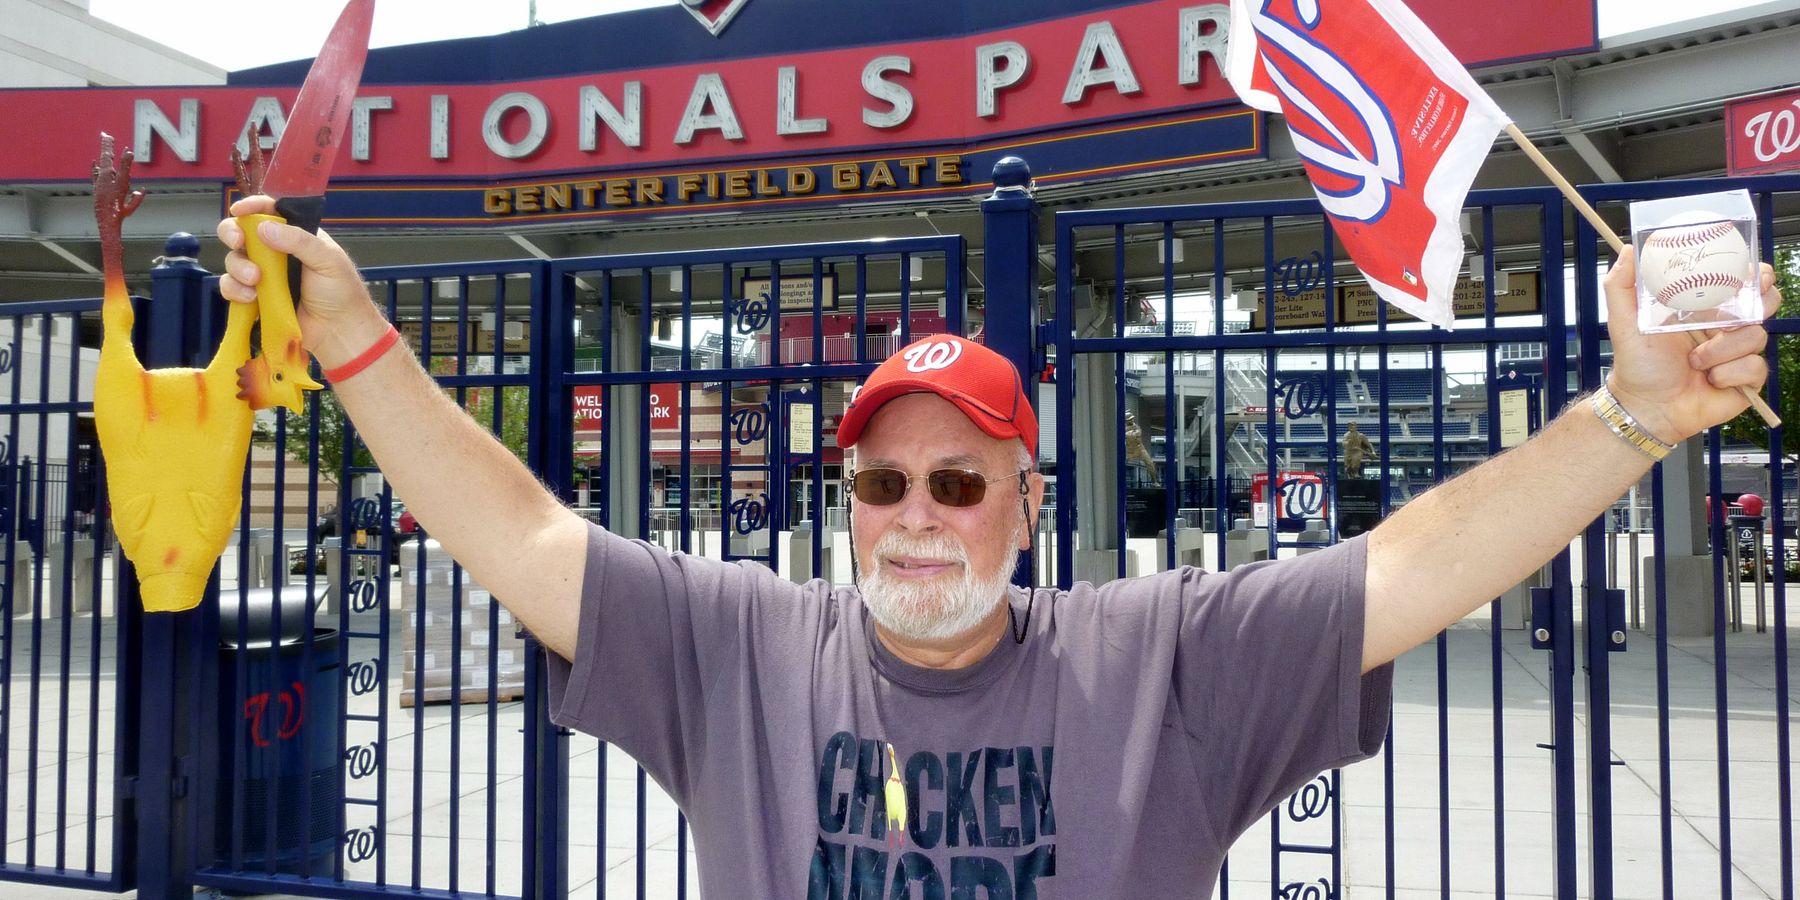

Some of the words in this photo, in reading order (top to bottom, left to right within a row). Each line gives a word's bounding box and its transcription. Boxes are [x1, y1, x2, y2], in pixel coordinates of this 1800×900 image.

[132, 55, 915, 164] NATIONALS
[975, 4, 1231, 118] PAR
[484, 177, 665, 214] CENTER
[677, 167, 816, 202] FIELD
[831, 155, 964, 191] GATE
[788, 297, 813, 305] inspecti
[1300, 293, 1325, 301] 127-14
[1275, 311, 1310, 321] coreboard
[903, 340, 963, 373] W
